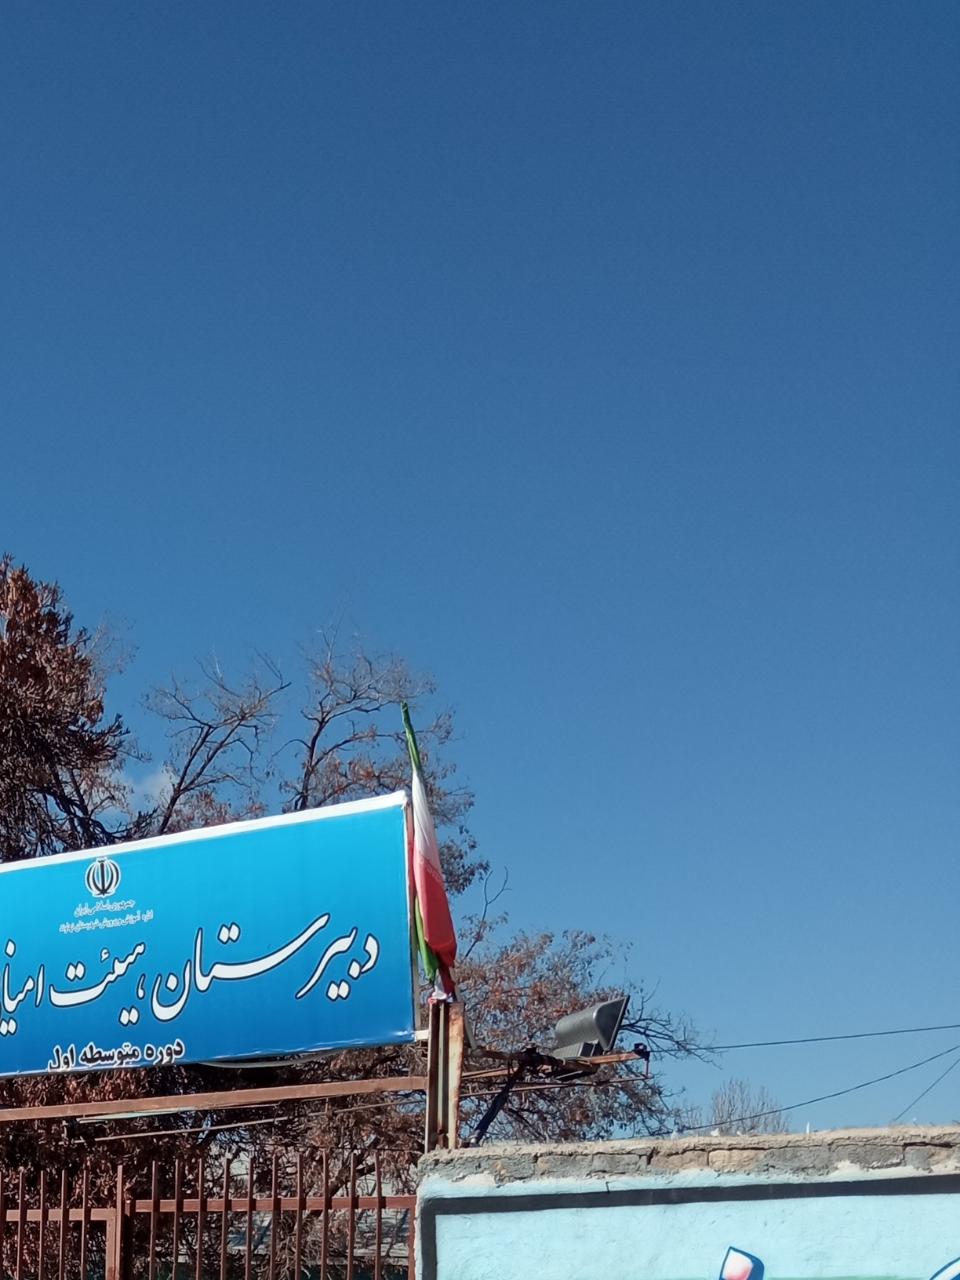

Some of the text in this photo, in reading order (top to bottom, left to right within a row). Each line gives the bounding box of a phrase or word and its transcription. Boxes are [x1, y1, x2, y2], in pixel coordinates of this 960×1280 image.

[151, 912, 379, 1021] دبیرستان
[48, 1038, 185, 1071] دوره متوسطه اول
